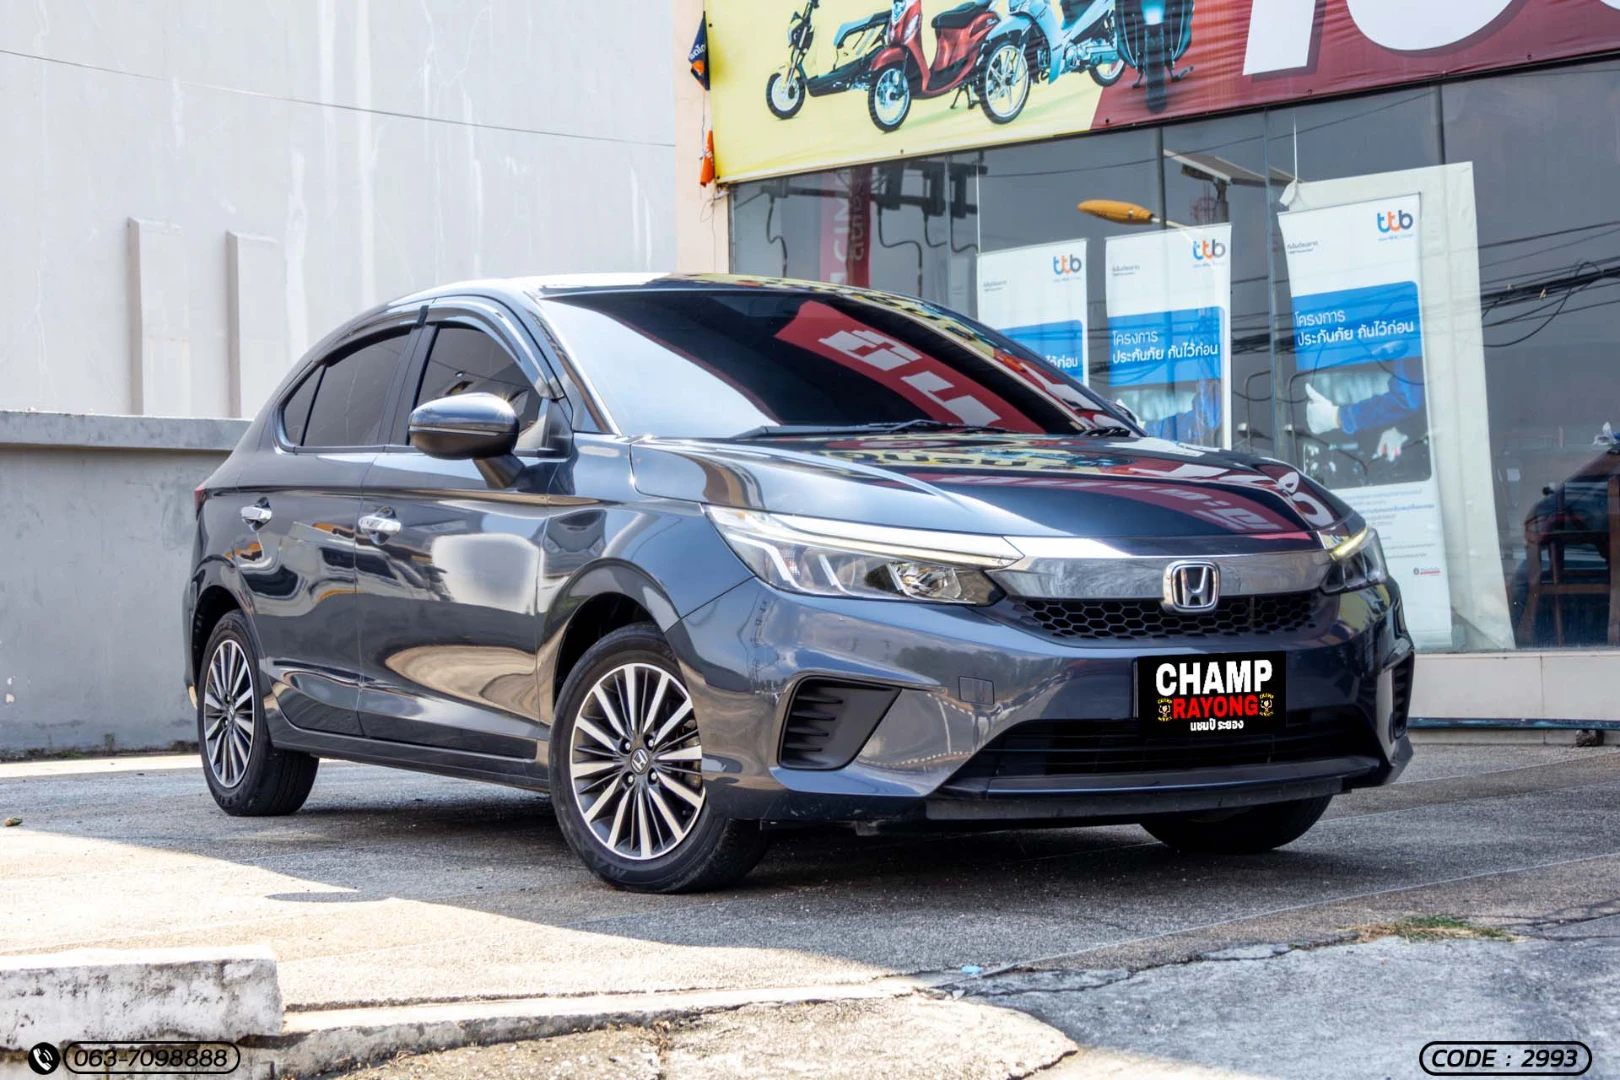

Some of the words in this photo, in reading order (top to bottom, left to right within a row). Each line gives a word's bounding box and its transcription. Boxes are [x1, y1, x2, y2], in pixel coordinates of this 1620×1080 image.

[1376, 209, 1414, 233] ttb
[1193, 239, 1226, 260] ttb
[1053, 254, 1082, 275] ttb
[1295, 310, 1346, 327] โครงการ
[1112, 331, 1158, 346] โครงการ
[1298, 326, 1354, 346] ประกันภัย
[1358, 320, 1414, 339] กันไว้ก่อน
[1112, 346, 1164, 364] ประกันภัย
[1168, 341, 1218, 359] กันไว้ก่อน
